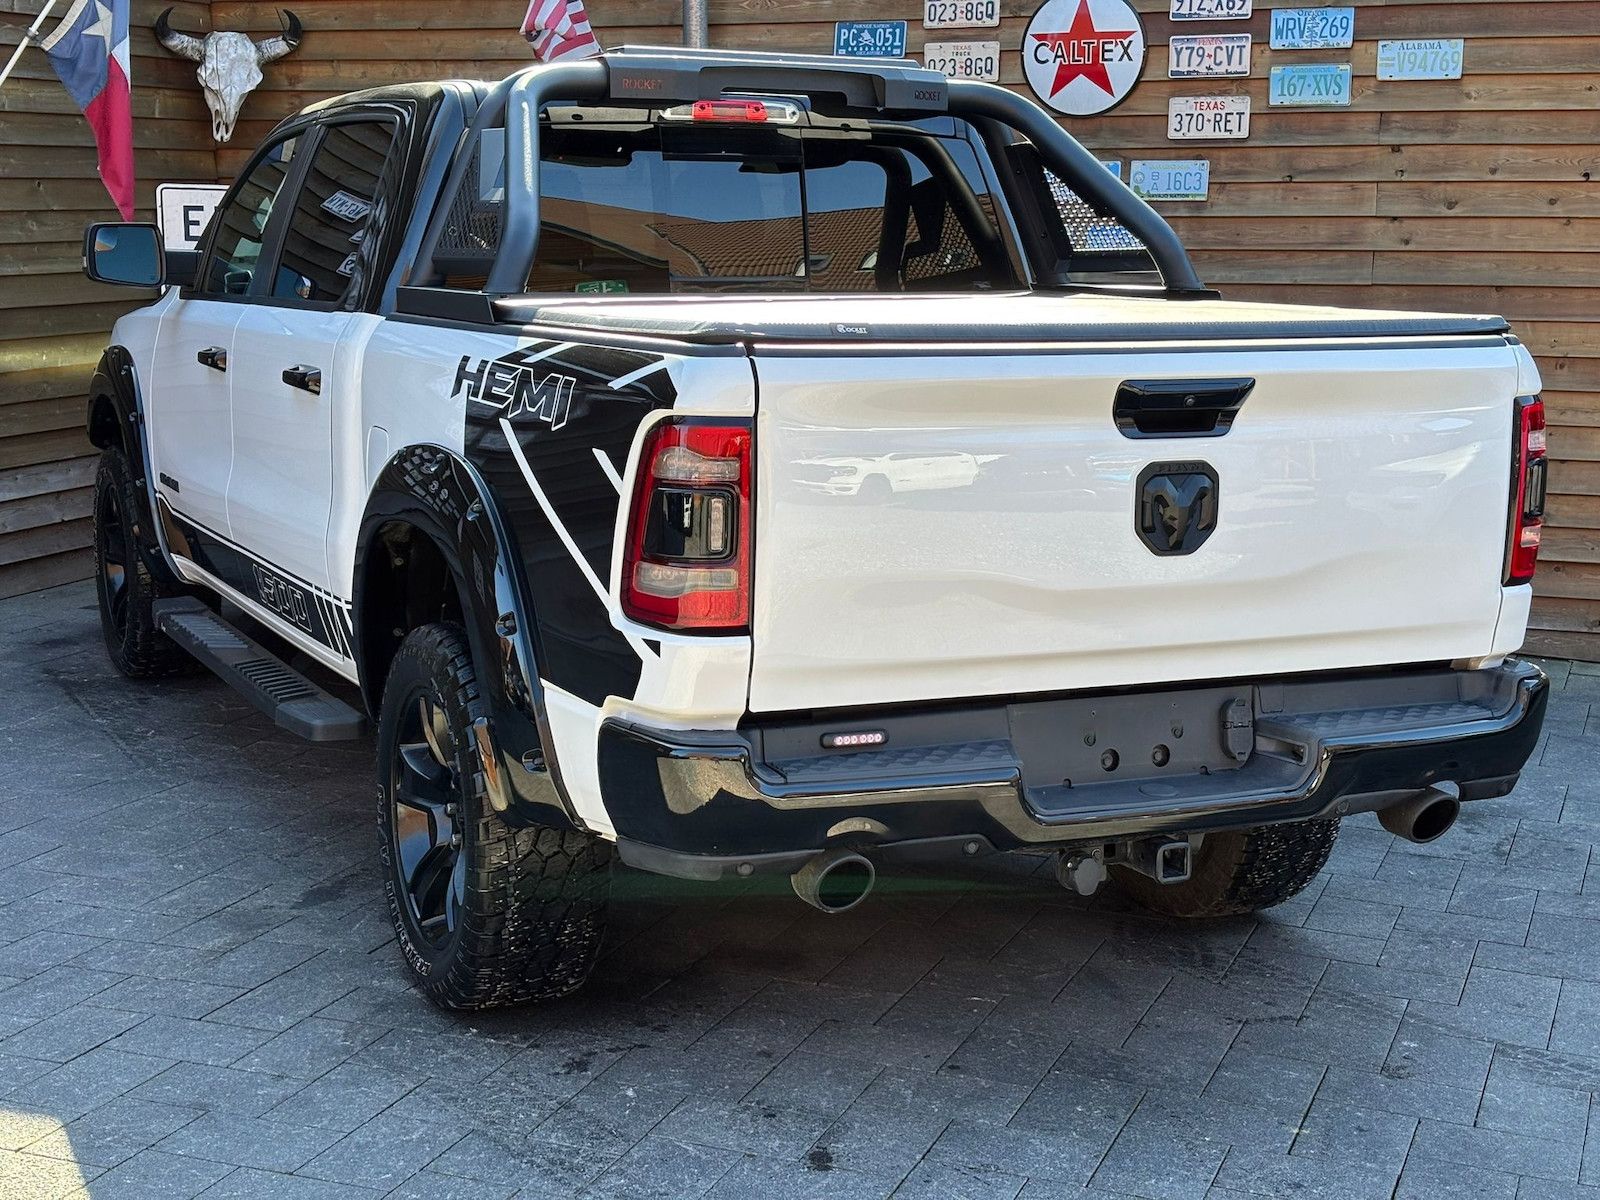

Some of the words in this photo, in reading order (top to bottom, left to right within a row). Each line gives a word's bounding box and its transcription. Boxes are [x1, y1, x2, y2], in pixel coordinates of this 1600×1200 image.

[840, 28, 858, 46] PC
[875, 28, 902, 46] 051
[1275, 17, 1307, 40] WRV
[1319, 16, 1349, 38] 269
[1033, 39, 1134, 65] CALTEX
[1174, 45, 1206, 68] Y79
[1213, 44, 1246, 66] CVT
[1398, 41, 1442, 51] ALABAMA
[964, 56, 993, 76] 8GQ
[622, 78, 663, 90] ROCKET
[914, 90, 941, 102] ROCKET
[1193, 101, 1226, 111] TEXAS
[1173, 112, 1205, 133] 370
[1213, 111, 1245, 133] RET
[449, 354, 577, 432] HEMI
[252, 563, 313, 632] 1500
